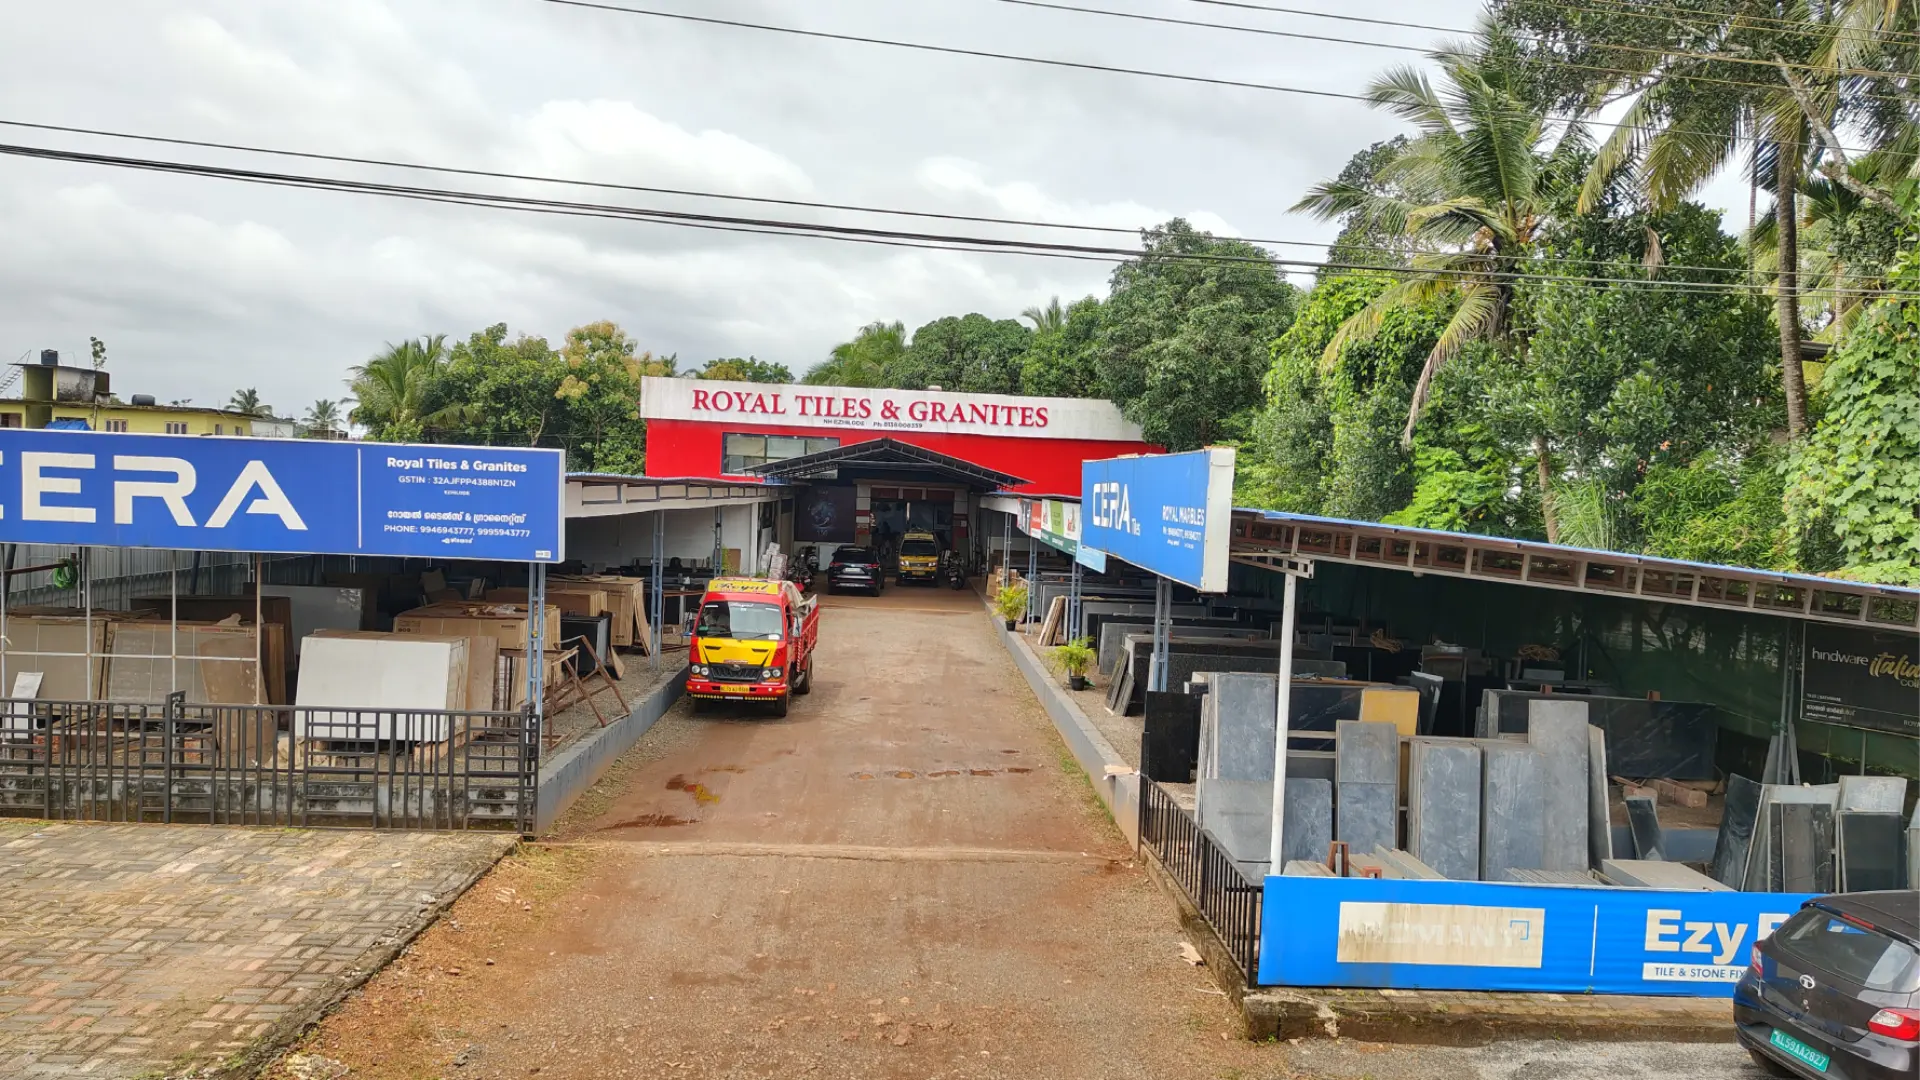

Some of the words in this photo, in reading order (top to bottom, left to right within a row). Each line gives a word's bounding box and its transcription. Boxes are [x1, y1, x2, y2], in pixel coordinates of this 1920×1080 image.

[692, 389, 787, 415] ROYAL
[795, 395, 872, 419] TILES
[880, 399, 901, 420] &
[908, 401, 1049, 428] GRANITES
[387, 457, 423, 470] Royal
[427, 458, 457, 470] Tiles
[460, 460, 470, 471] &
[473, 460, 527, 473] Granites
[398, 475, 426, 484] GSTIN
[0, 451, 308, 531] ERA
[465, 513, 472, 521] &
[1093, 482, 1131, 534] CERA
[384, 525, 418, 533] PHONE:
[1812, 646, 1869, 666] hindware
[1644, 909, 1749, 965] Ezy
[1655, 967, 1675, 976] TILE
[1678, 967, 1687, 976] &
[1690, 968, 1726, 978] STONE
